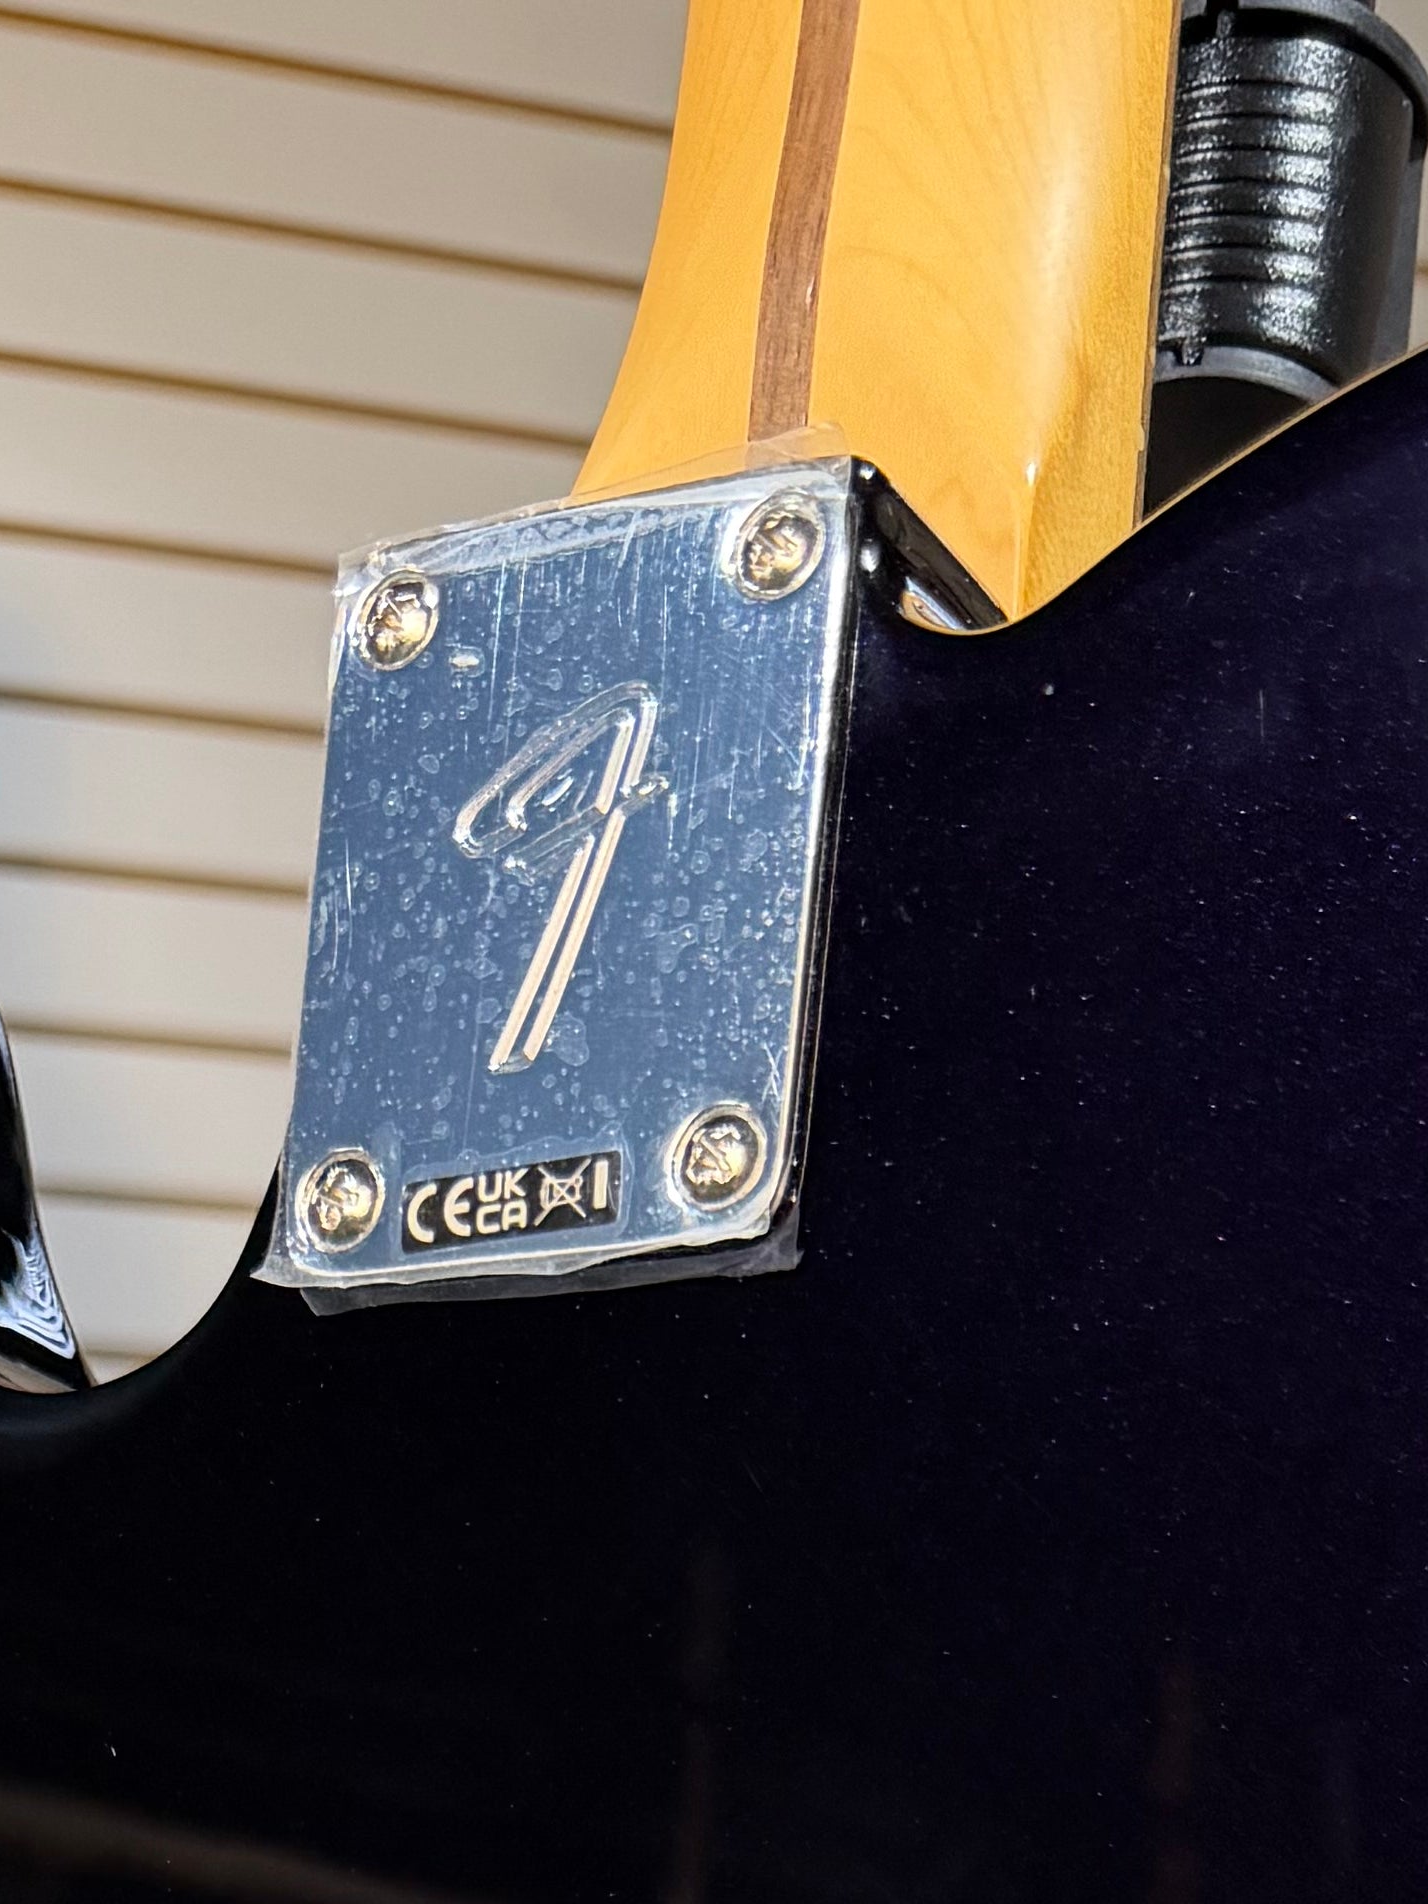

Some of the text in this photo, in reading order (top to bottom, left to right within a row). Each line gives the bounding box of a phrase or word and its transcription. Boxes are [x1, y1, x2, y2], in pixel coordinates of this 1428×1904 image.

[477, 1168, 529, 1203] UK
[407, 1176, 474, 1244] CE
[475, 1200, 528, 1235] CA
